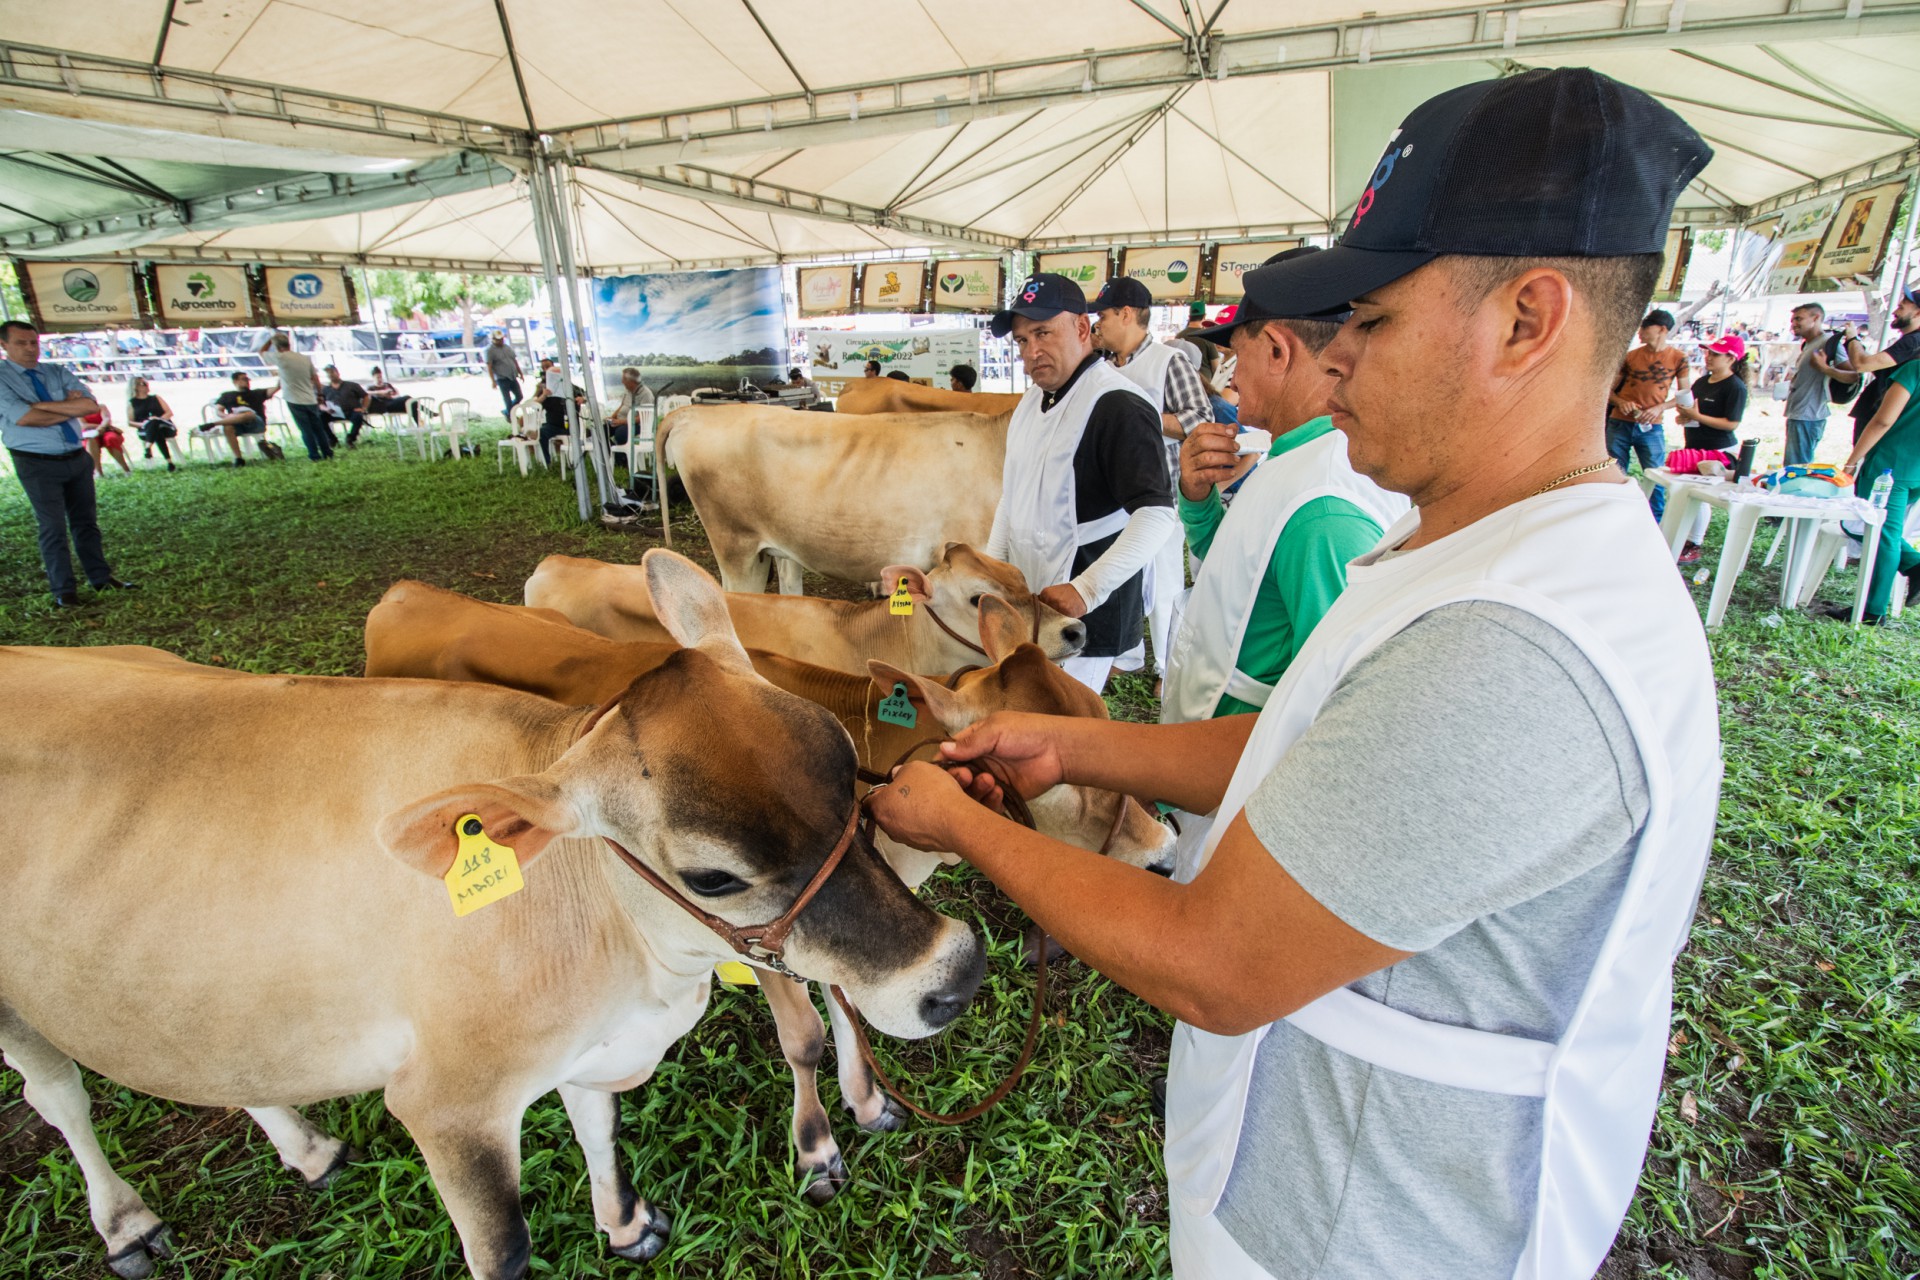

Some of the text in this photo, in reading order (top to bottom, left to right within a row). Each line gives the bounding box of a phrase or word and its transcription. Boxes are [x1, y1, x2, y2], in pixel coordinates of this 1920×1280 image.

[965, 270, 983, 283] Valle
[1127, 267, 1166, 279] Vet&Agro
[967, 283, 989, 293] Verde
[53, 303, 75, 313] Casa
[87, 303, 118, 313] Campo
[170, 297, 237, 312] Agrocentro
[891, 351, 913, 361] 2022
[884, 699, 904, 708] 129
[461, 847, 491, 877] 118
